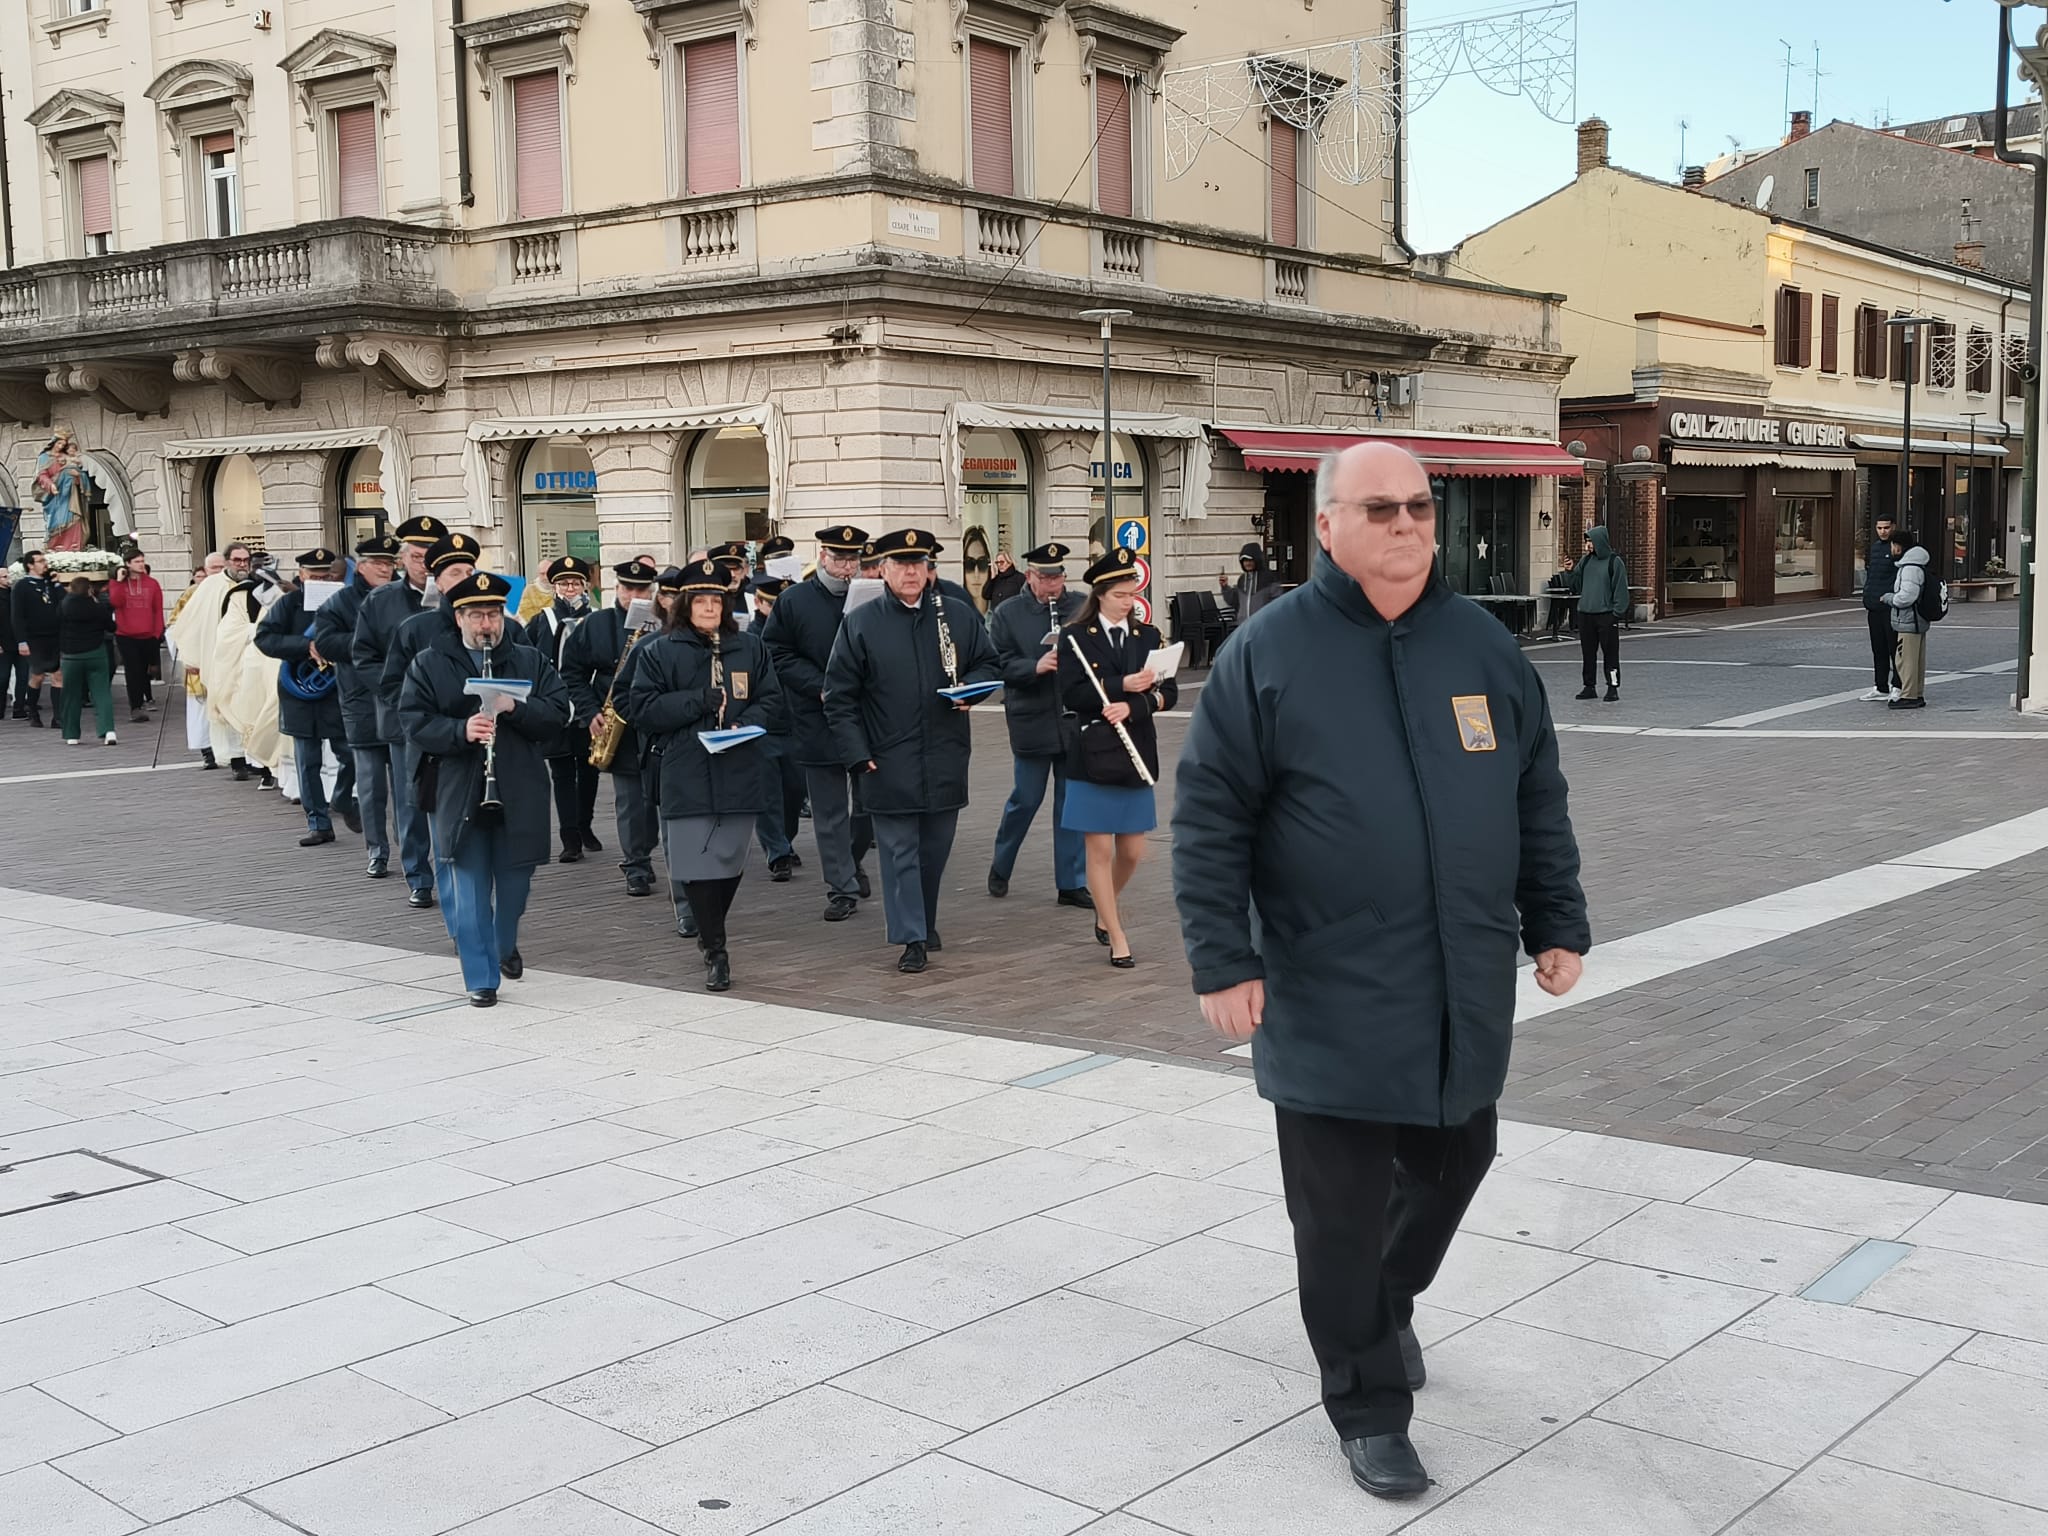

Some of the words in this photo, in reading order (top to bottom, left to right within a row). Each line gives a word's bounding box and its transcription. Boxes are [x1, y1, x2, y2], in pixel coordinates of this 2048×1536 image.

[908, 212, 919, 221] VIA
[1670, 412, 1780, 442] CALZATURE
[1787, 421, 1846, 447] GUISAR
[961, 457, 1017, 471] EGAVISION
[1089, 462, 1132, 478] TTCA
[535, 470, 597, 490] OTTICA
[352, 482, 385, 494] MEGA
[963, 493, 992, 505] UCCI
